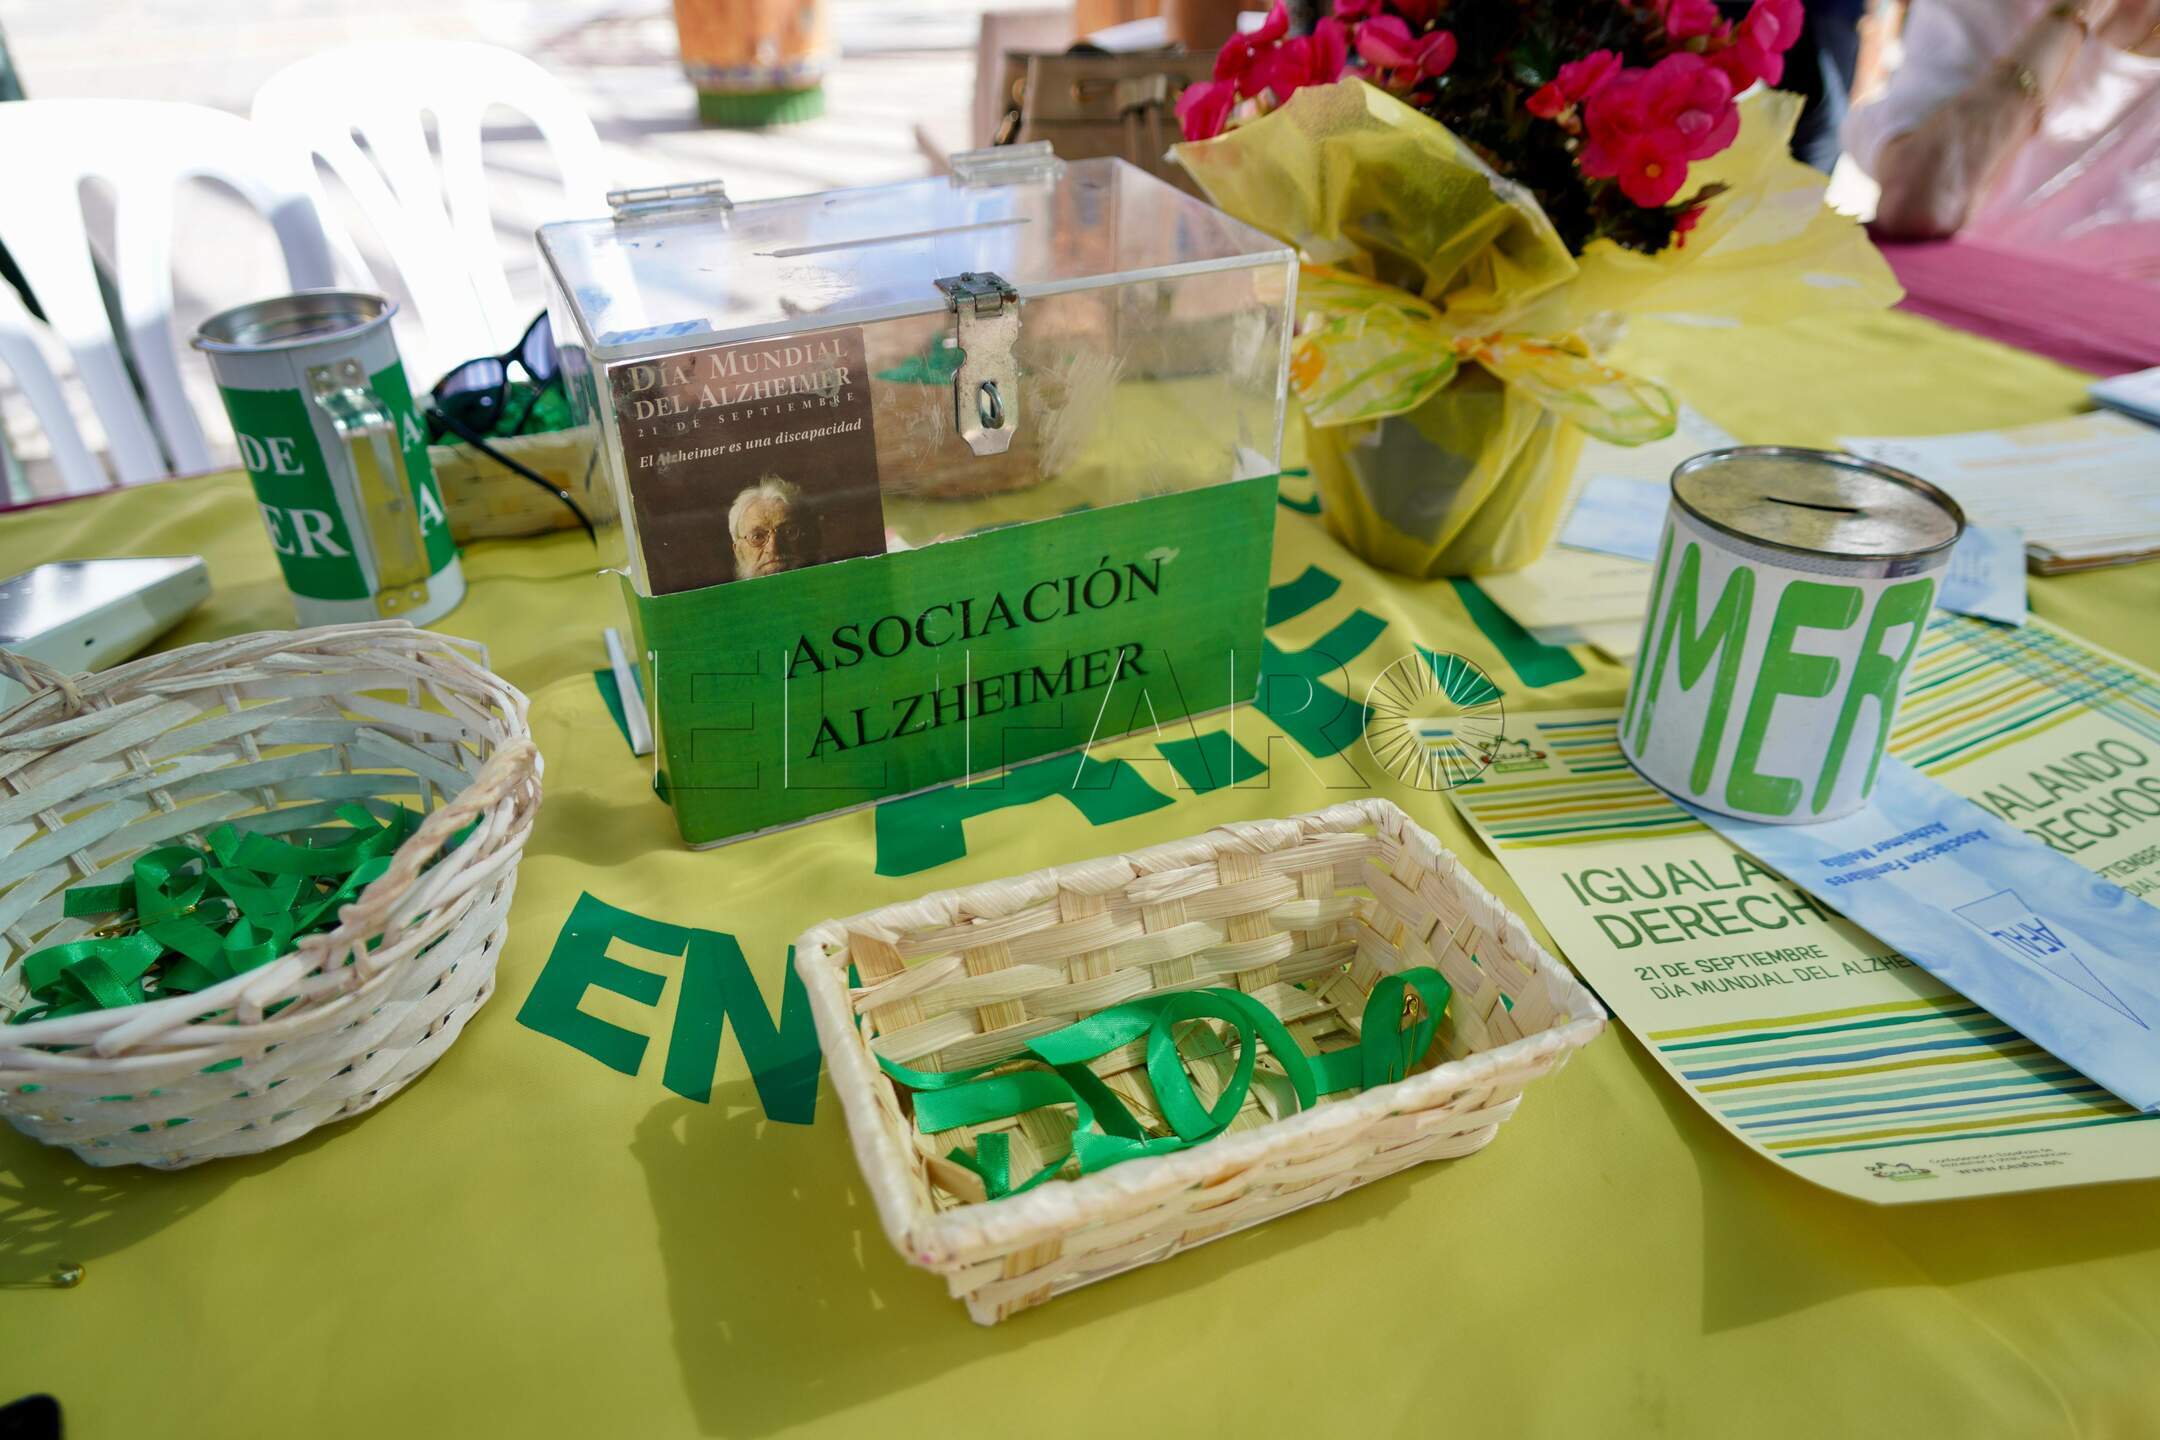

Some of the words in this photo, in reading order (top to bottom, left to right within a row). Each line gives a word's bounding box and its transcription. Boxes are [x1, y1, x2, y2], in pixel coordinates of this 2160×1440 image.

[630, 361, 690, 393] DÍA
[709, 338, 849, 380] MUNDIAL
[635, 396, 690, 421] DEL
[698, 366, 853, 411] ALZHEIMER
[638, 425, 658, 438] 21
[676, 418, 702, 432] DE
[718, 391, 856, 425] SEPTIEMBRE
[639, 454, 654, 468] El
[728, 441, 743, 454] es
[745, 436, 772, 450] una
[775, 417, 863, 445] discapacidad
[783, 555, 1166, 681] ASOCIACIÓN
[806, 642, 1150, 760] ALZHEIMER
[1561, 853, 1786, 907] IGUALA
[1593, 887, 1848, 950] DERECH
[1634, 965, 1661, 982] 21
[1663, 962, 1695, 979] DE
[1694, 944, 1830, 975] SEPTIEMBRE
[1650, 979, 1692, 1001] DÍA
[1691, 970, 1794, 996] MUNDIAL
[1792, 965, 1839, 982] DEL
[1841, 952, 1917, 977] ALZHE
